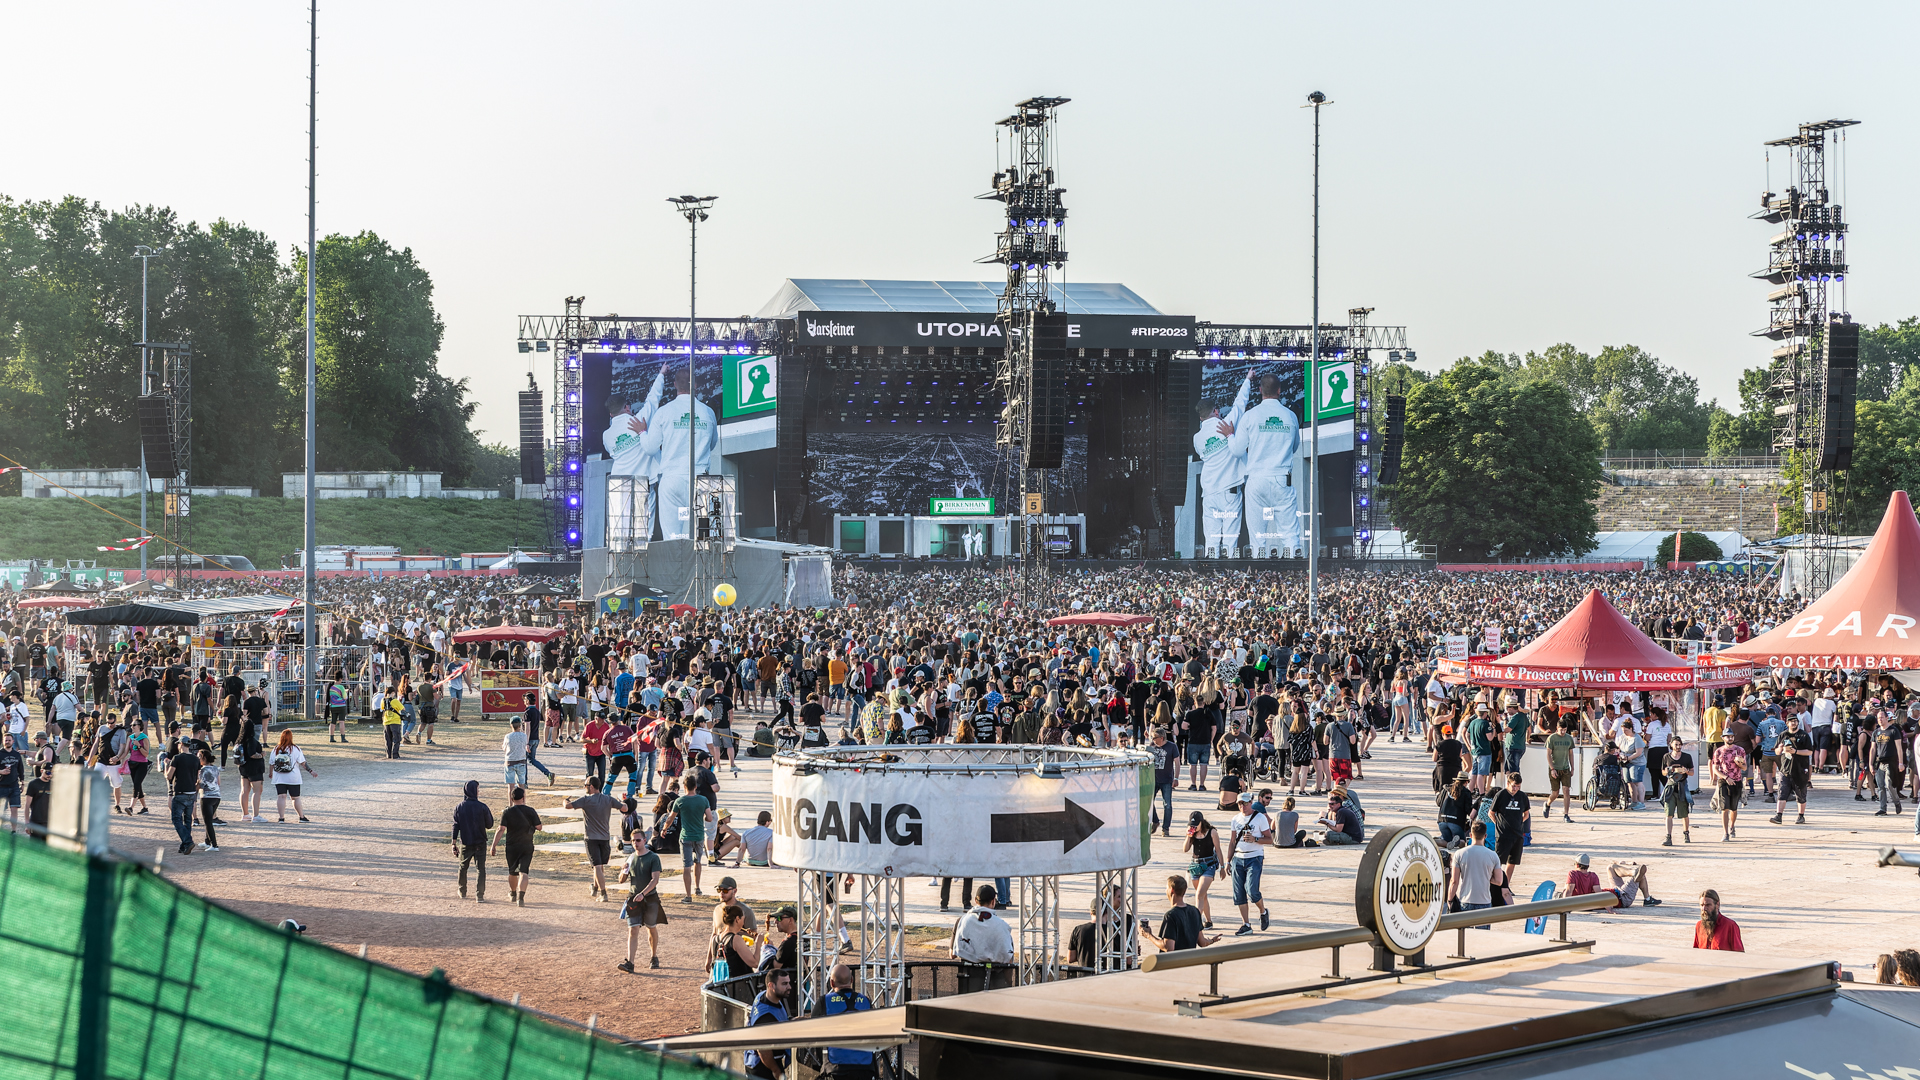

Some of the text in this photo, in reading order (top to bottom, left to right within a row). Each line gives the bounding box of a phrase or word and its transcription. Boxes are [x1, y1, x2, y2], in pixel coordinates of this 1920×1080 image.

[917, 322, 1002, 337] UTOPIA
[1131, 327, 1188, 337] #RIP2023
[1030, 501, 1037, 511] 5
[1816, 499, 1823, 508] 6
[1786, 611, 1917, 639] BAR
[1768, 655, 1904, 669] COCKTAILBAR
[1472, 664, 1503, 679] Wein
[1504, 666, 1517, 680] &
[1517, 667, 1571, 682] Prosecco
[1581, 669, 1692, 683] Wein & Prosecco
[1717, 666, 1723, 680] &
[1723, 666, 1752, 679] Prosecco
[773, 794, 923, 847] INGANG
[1392, 855, 1403, 873] SEIT
[1386, 873, 1441, 907] Warsteiner
[1390, 914, 1400, 930] DAS
[1399, 928, 1419, 940] EINZIG
[830, 995, 864, 1003] SECTY
